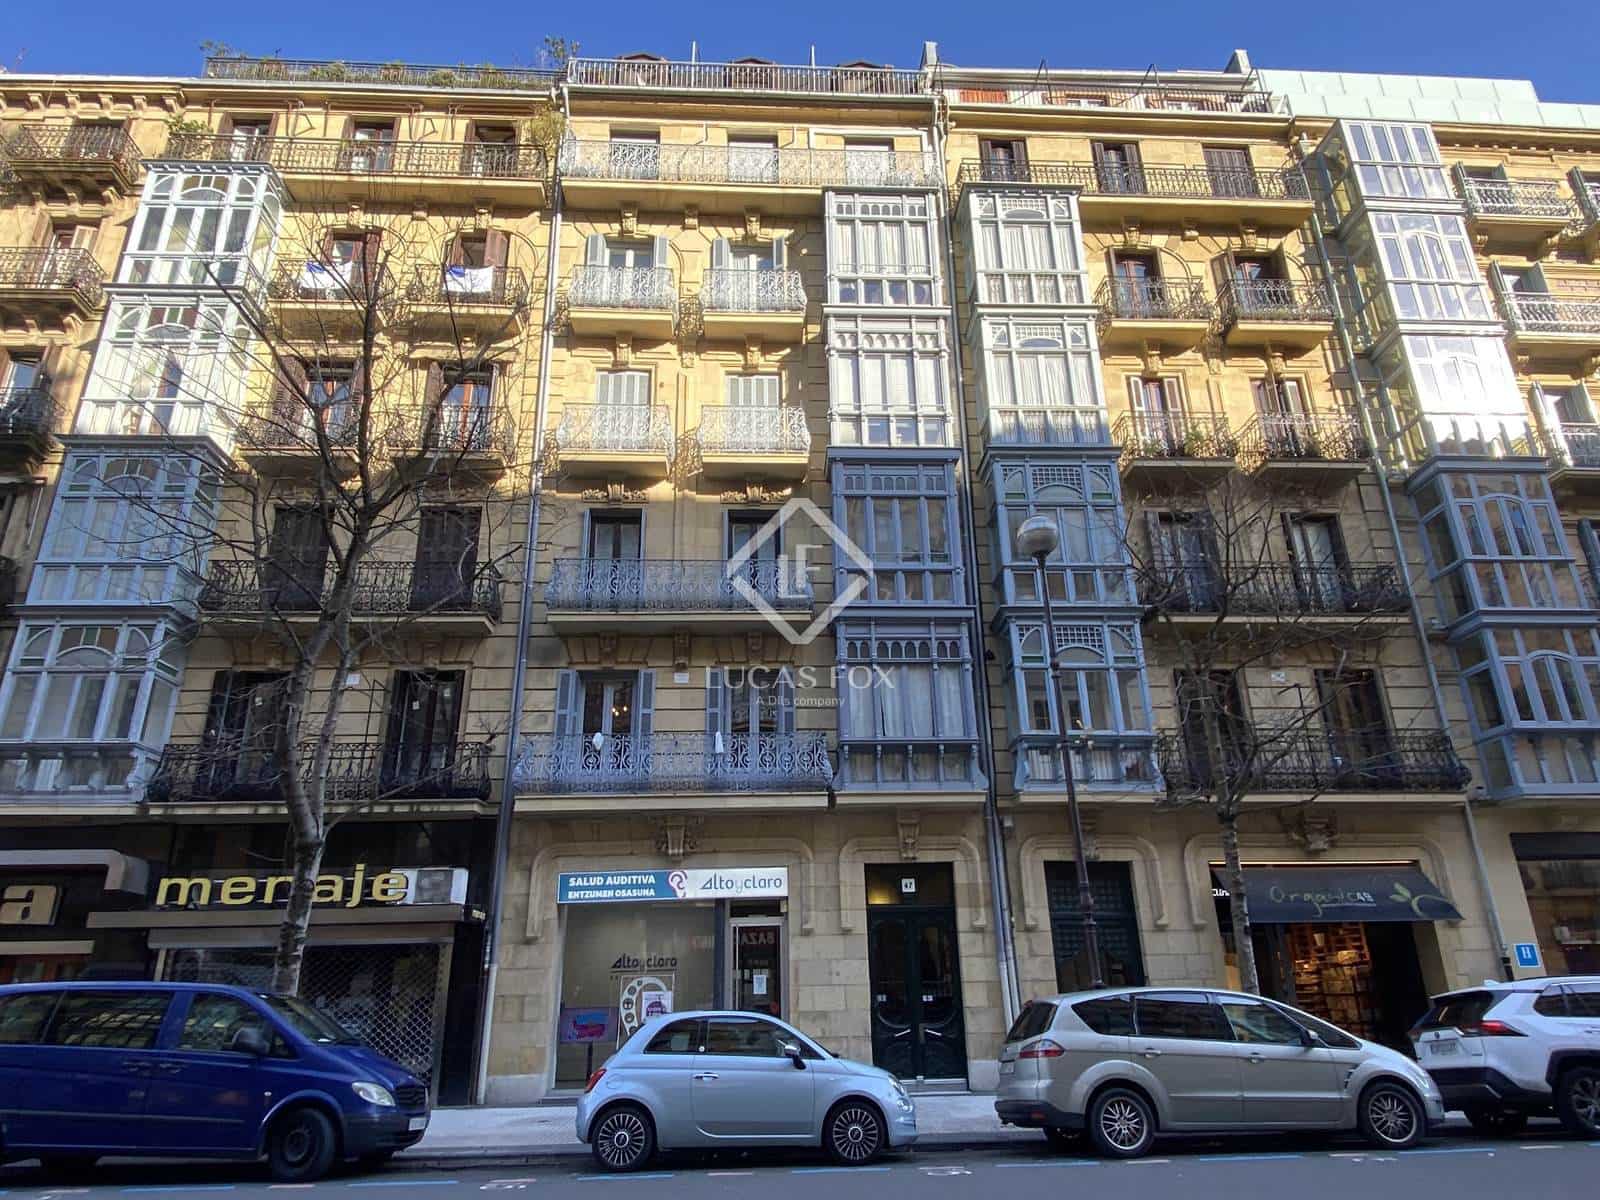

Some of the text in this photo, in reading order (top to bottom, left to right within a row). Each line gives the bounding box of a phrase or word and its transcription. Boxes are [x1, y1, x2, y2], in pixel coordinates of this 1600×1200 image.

[568, 875, 656, 887] SALUD AUDITIVA
[568, 888, 656, 899] ENTZUMEN OSASUNA
